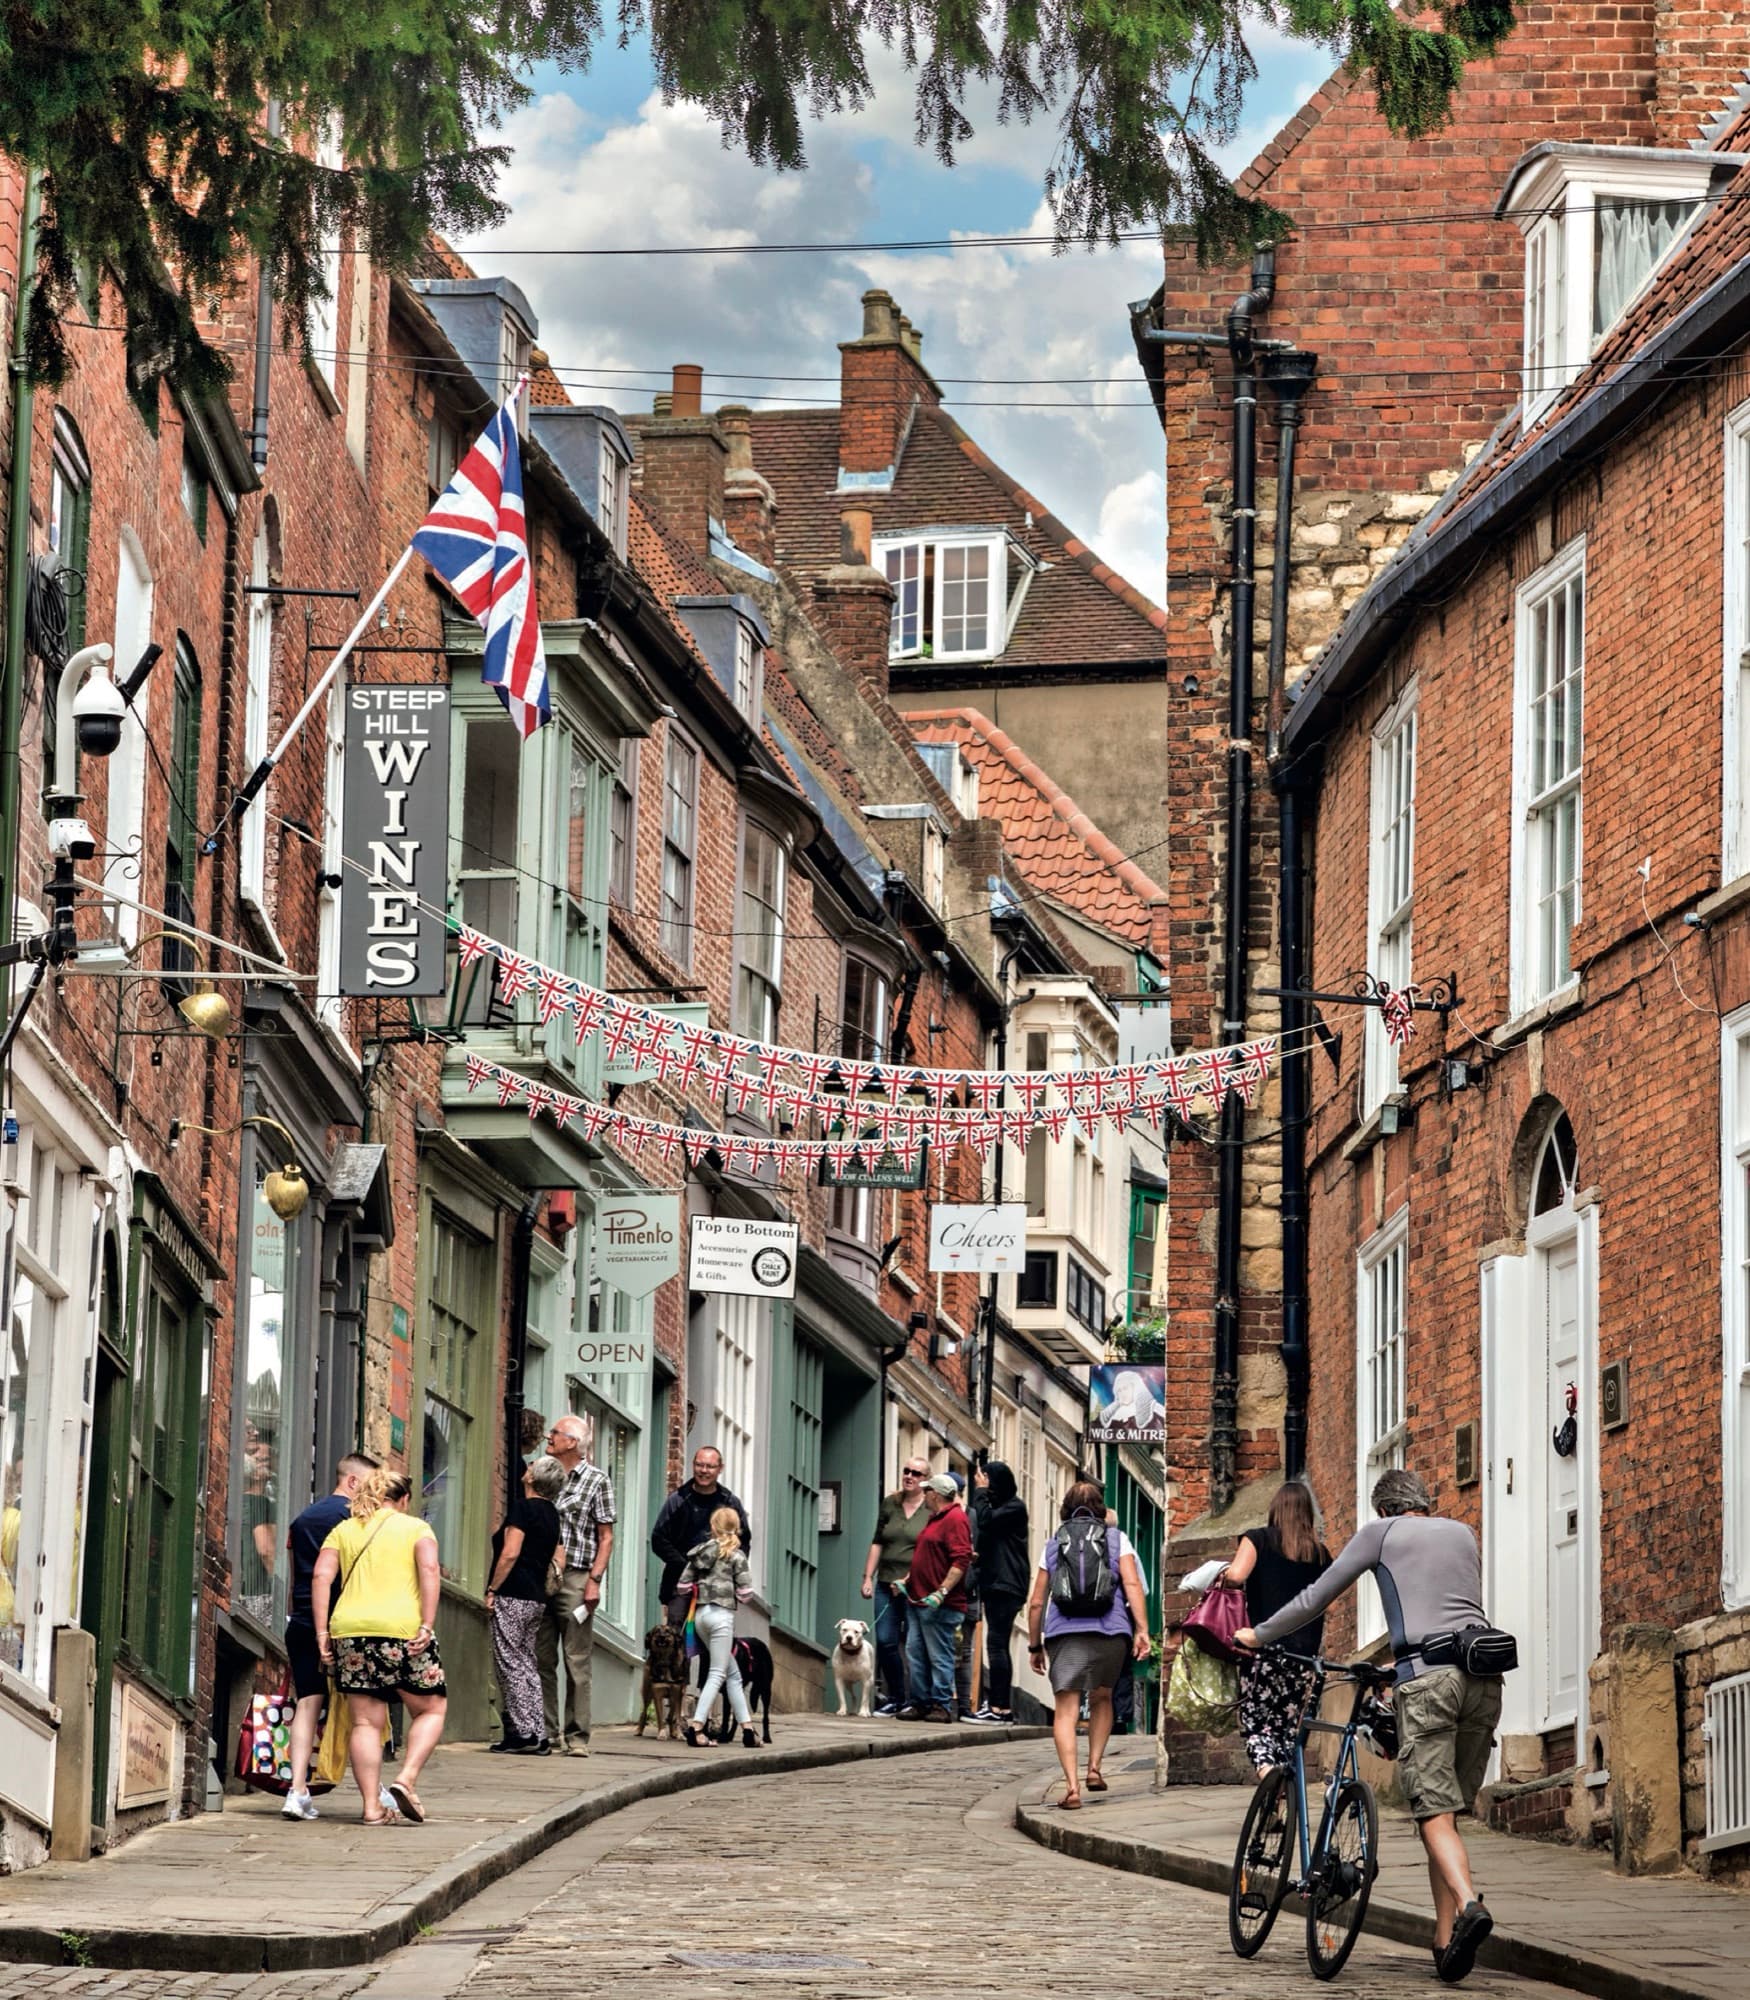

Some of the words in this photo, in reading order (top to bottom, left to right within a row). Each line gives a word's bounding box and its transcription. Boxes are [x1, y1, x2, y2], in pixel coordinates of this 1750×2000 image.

[351, 690, 446, 711] STEEP
[365, 715, 430, 735] HILL
[363, 740, 432, 988] WINES
[602, 1209, 673, 1245] Pimento
[695, 1219, 722, 1235] Top
[726, 1223, 740, 1234] to
[744, 1223, 795, 1239] Bottom
[939, 1208, 1017, 1248] Cheers
[698, 1243, 748, 1254] Accessories
[606, 1255, 650, 1263] VEGETARIAN
[697, 1257, 743, 1268] Homeware
[696, 1271, 704, 1279] &
[705, 1271, 727, 1281] Gifts
[577, 1343, 645, 1363] OPEN
[1091, 1428, 1114, 1440] WIG
[1116, 1429, 1126, 1440] &
[1127, 1428, 1167, 1441] MITRE
